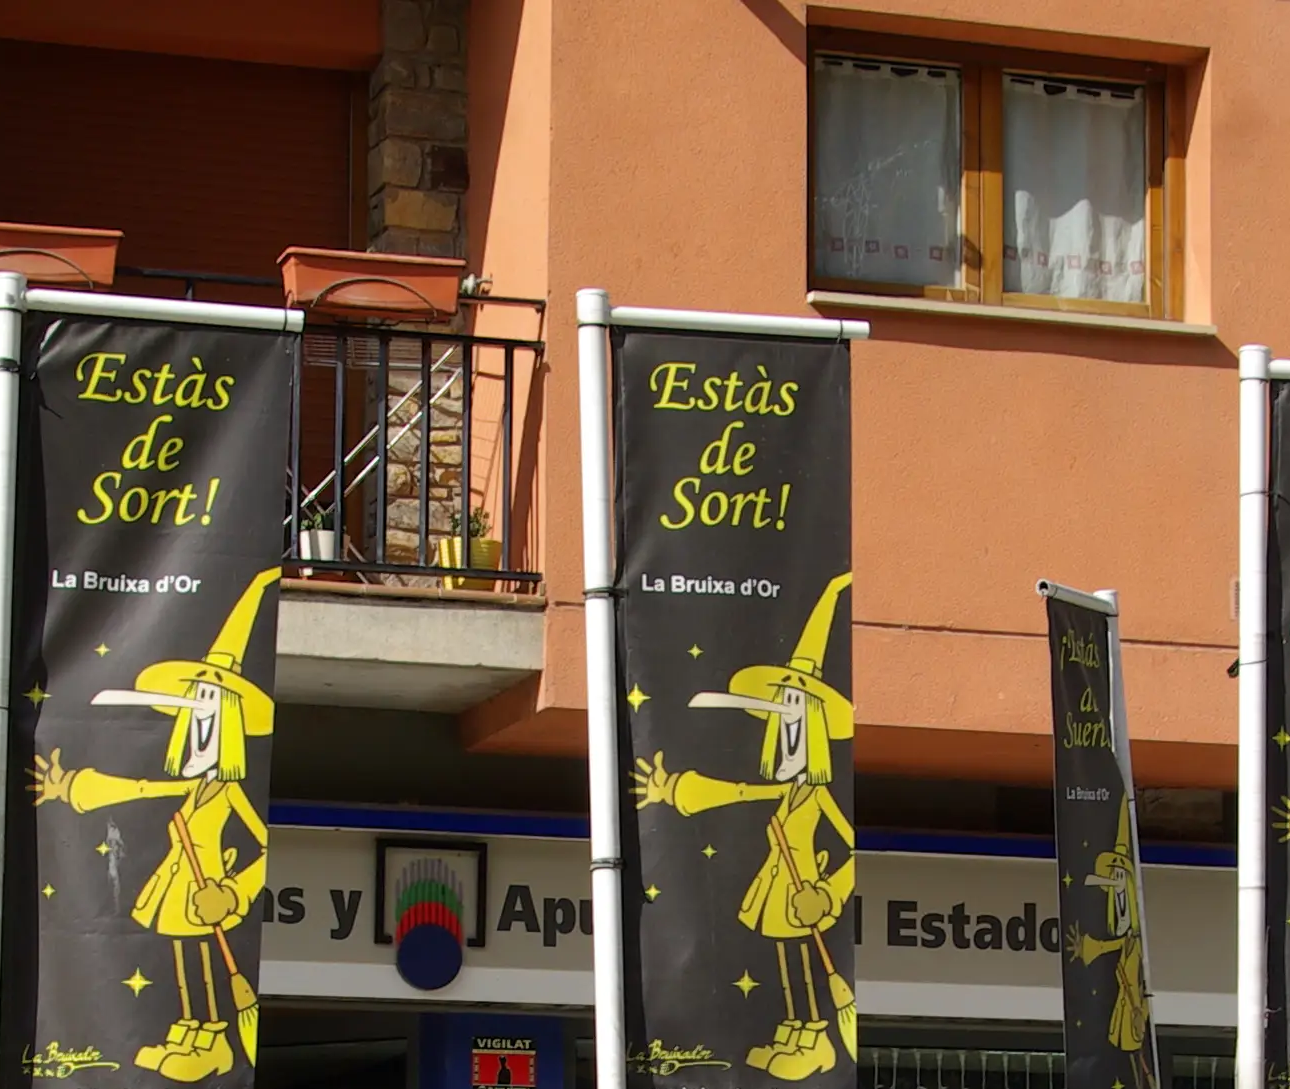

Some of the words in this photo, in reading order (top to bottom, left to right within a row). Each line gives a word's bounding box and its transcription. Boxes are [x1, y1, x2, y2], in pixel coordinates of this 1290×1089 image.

[75, 352, 236, 411] Estàs
[649, 361, 799, 416] Estàs
[121, 414, 184, 471] de
[699, 420, 756, 476] de
[77, 471, 220, 526] Sort!
[660, 476, 791, 531] Sort!
[52, 569, 76, 588] La
[83, 571, 150, 593] Bruixa
[155, 574, 201, 593] d'Or
[641, 574, 665, 593] La
[671, 575, 735, 595] Bruixa
[740, 579, 780, 598] d'Or
[329, 889, 364, 940] y
[887, 899, 1060, 953] Estado
[476, 1038, 532, 1050] VIGILAT
